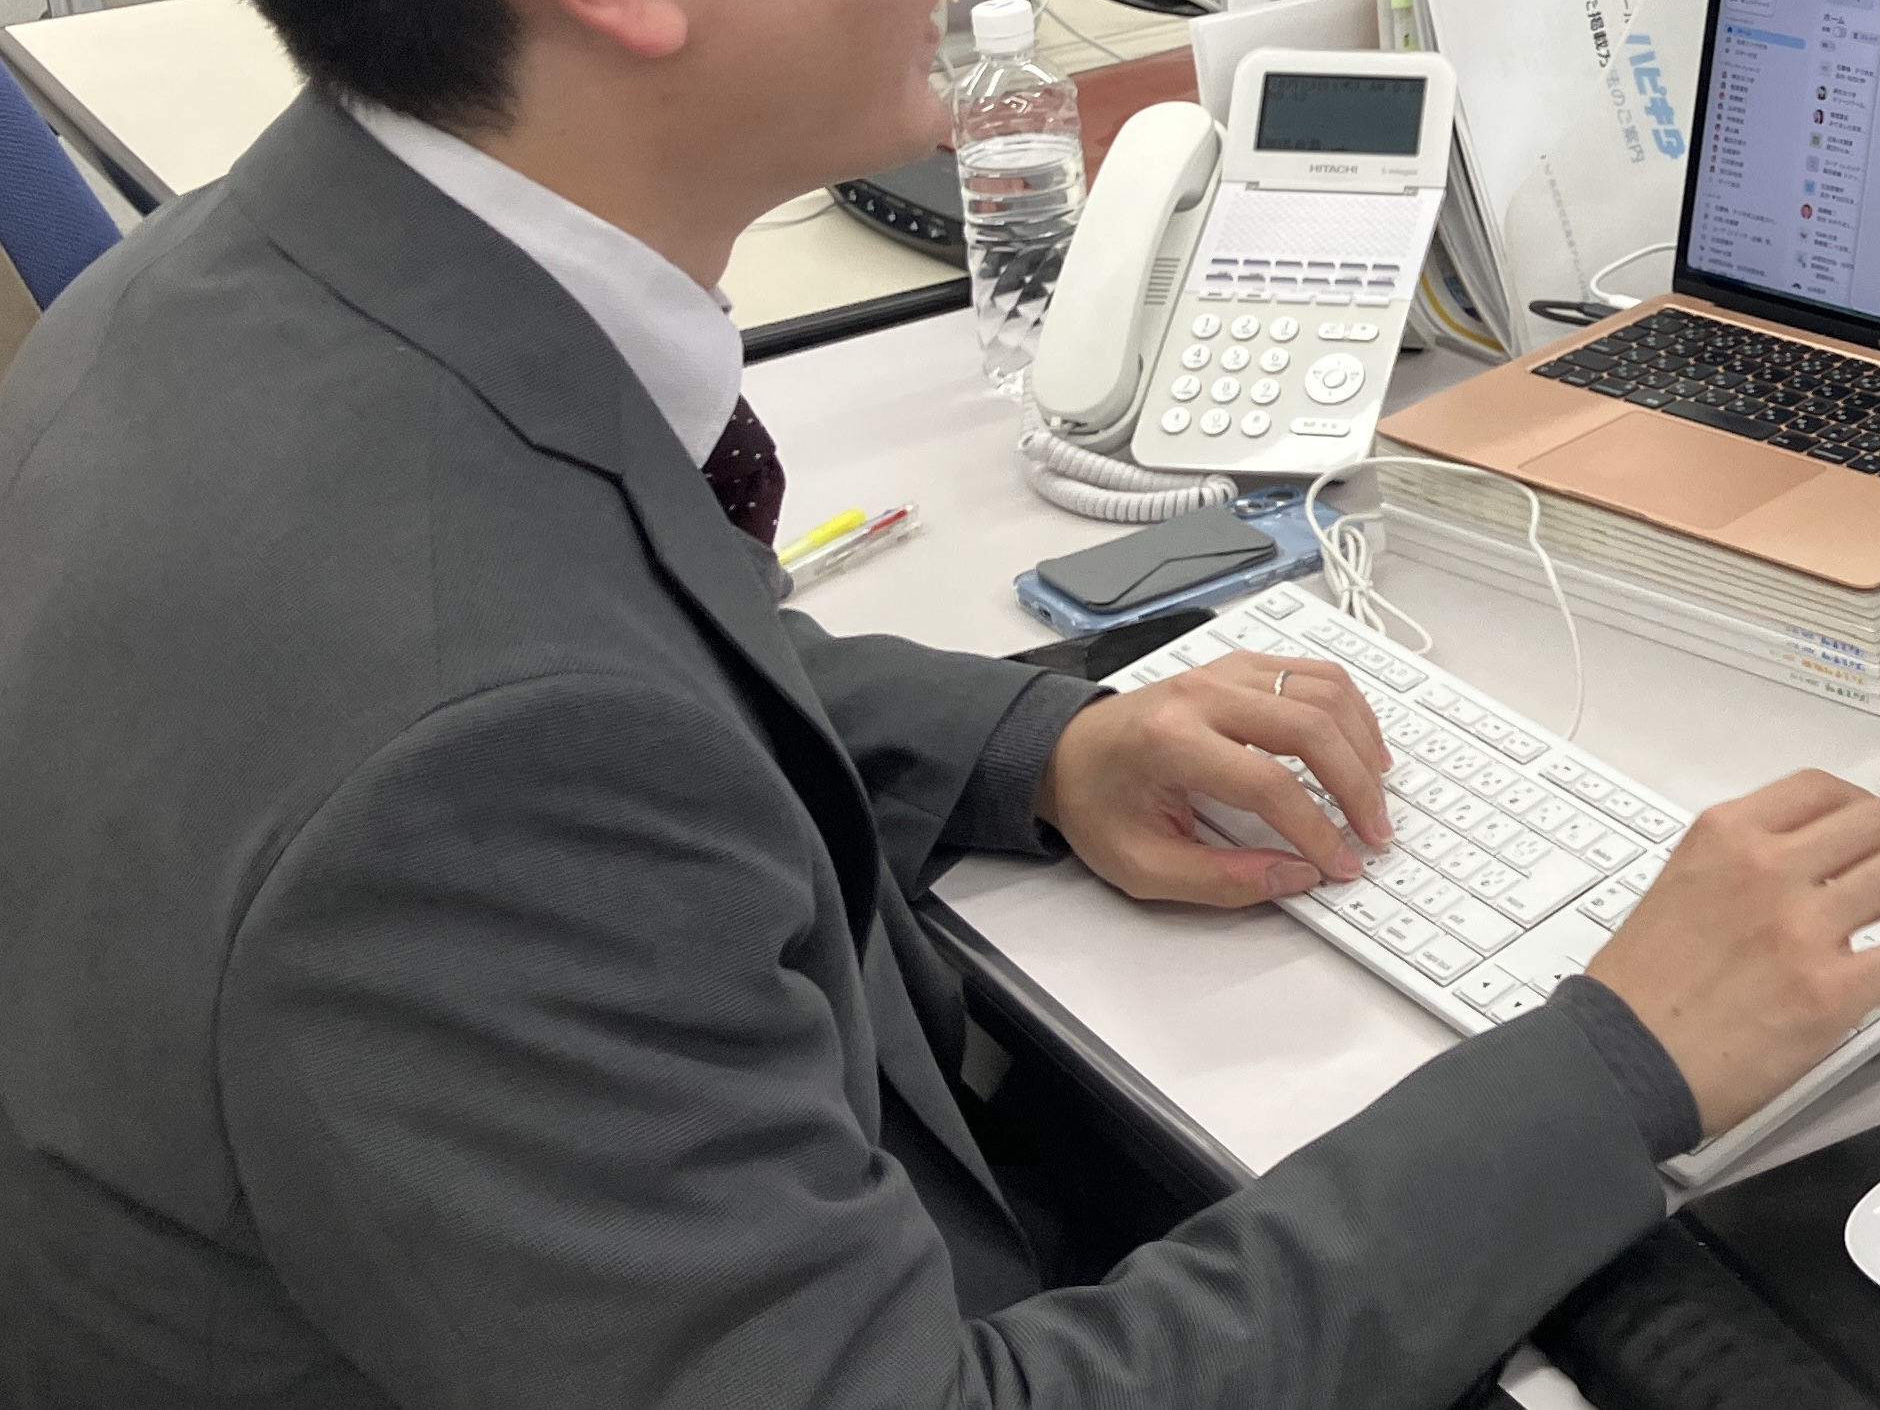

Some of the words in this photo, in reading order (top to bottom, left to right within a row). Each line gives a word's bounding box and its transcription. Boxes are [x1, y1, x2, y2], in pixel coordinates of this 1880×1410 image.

[1823, 13, 1845, 25] ホーム
[1309, 164, 1358, 174] HITACHI
[1193, 348, 1201, 359] 4
[1233, 350, 1241, 360] 5
[1271, 352, 1279, 361] 6
[1263, 383, 1271, 392] 9
